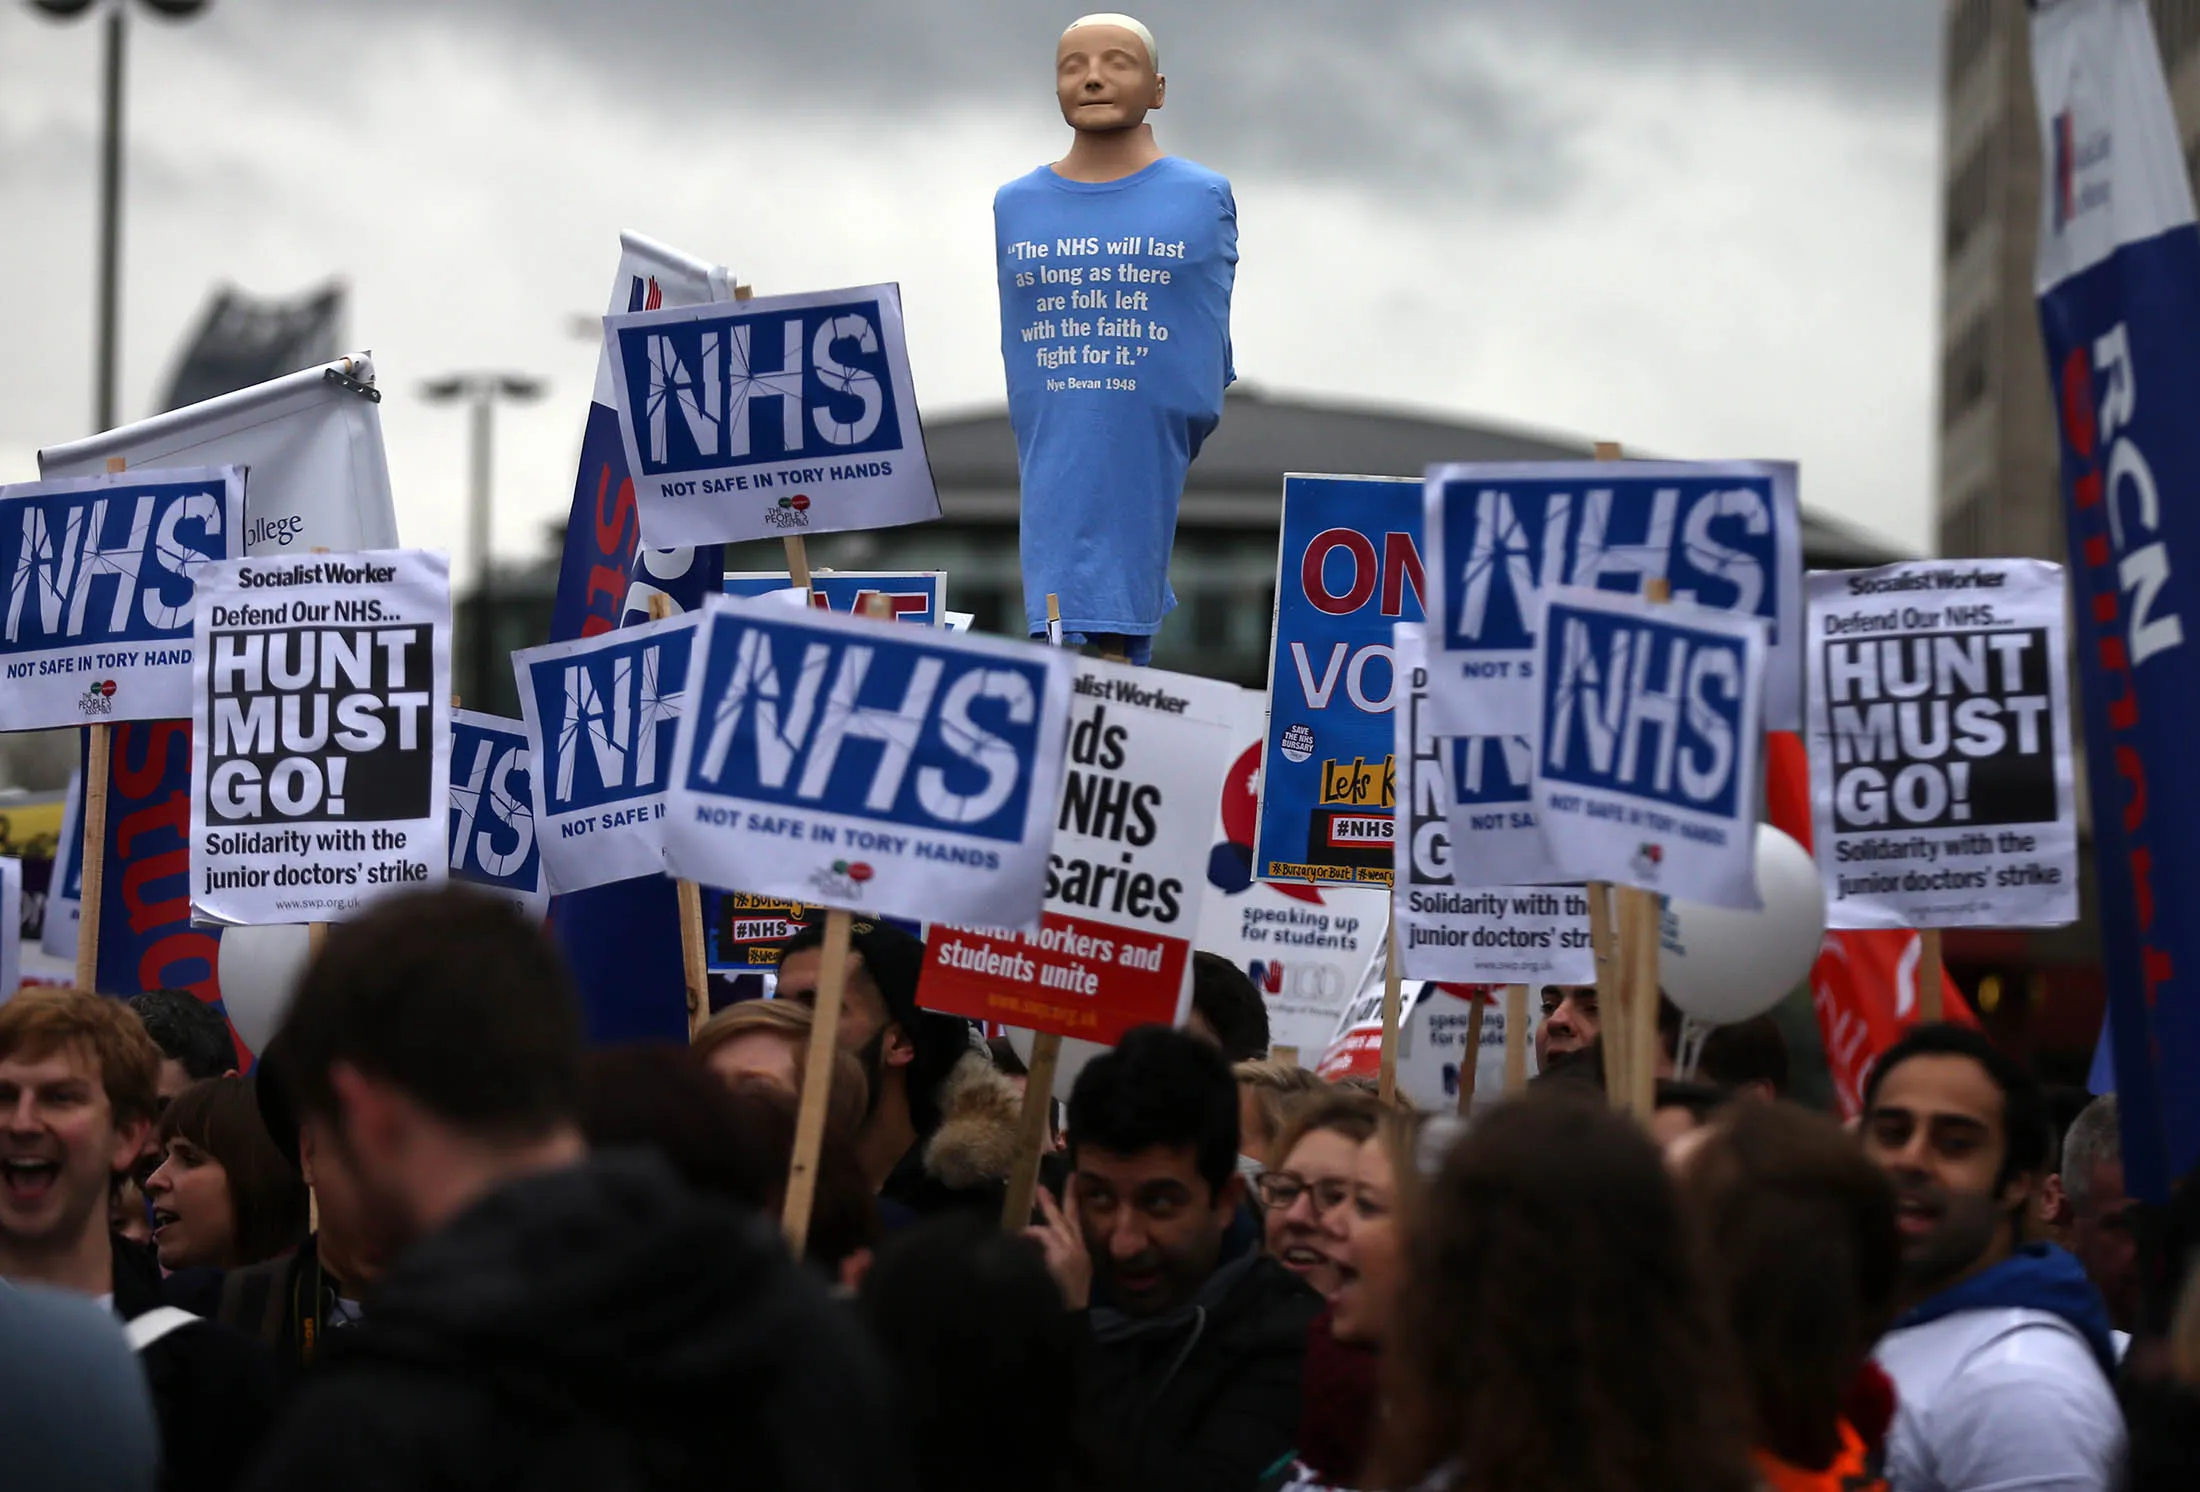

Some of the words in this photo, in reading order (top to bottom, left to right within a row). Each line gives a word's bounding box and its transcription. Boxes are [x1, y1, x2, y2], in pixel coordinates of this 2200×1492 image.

[1056, 237, 1099, 256] NHS
[1107, 237, 1141, 255] will
[1148, 237, 1185, 258] last
[1016, 271, 1035, 287] as
[1041, 265, 1083, 285] long
[1089, 267, 1111, 282] as
[1118, 263, 1171, 285] there
[1037, 296, 1065, 312] are
[1071, 289, 1108, 309] folk
[1115, 290, 1148, 311] left
[1021, 319, 1055, 342] with
[1061, 318, 1091, 337] the
[1097, 317, 1141, 338] faith
[1148, 321, 1168, 341] to
[1036, 346, 1077, 369] fight
[1082, 344, 1110, 364] for
[646, 313, 883, 464] NHS
[1047, 378, 1065, 392] Nye
[1068, 377, 1101, 389] Bevan
[1105, 378, 1136, 391] 1948
[660, 481, 697, 498] NOT
[702, 476, 749, 494] SAFE
[753, 472, 774, 488] IN
[778, 467, 825, 487] TORY
[831, 461, 893, 481] HANDS
[2093, 321, 2184, 667] RCN
[5, 492, 221, 643] NHS
[238, 563, 322, 588] Socialist
[324, 563, 396, 584] Worker
[1458, 488, 1770, 641] NHS
[1848, 571, 1933, 595] Socialist
[1936, 568, 2006, 589] Worker
[211, 602, 287, 627] Defend
[292, 600, 330, 622] Our
[335, 600, 401, 622] NHS...
[1824, 609, 1898, 635] Defend
[1902, 607, 1940, 629] Our
[7, 662, 35, 679] NOT
[39, 657, 74, 675] SAFE
[78, 656, 92, 671] IN
[97, 652, 138, 669] TORY
[144, 649, 194, 666] HAND
[214, 629, 416, 693] HUNT
[1462, 661, 1511, 679] NOT
[1827, 633, 2032, 701] HUNT
[1116, 680, 1190, 715] Worker
[1550, 616, 1739, 802] NHS
[213, 692, 429, 757] MUST
[699, 628, 1036, 824] NHS
[1070, 704, 1128, 770] ds
[1285, 731, 1298, 742] THE
[1291, 725, 1309, 736] SAVE
[1831, 695, 2048, 764] MUST
[1281, 739, 1314, 752] BURSARY
[208, 756, 347, 820] GO!
[1836, 761, 1971, 826] GO!
[562, 817, 596, 838] NOT
[602, 806, 649, 829] SAFE
[1058, 770, 1162, 847] NHS
[1470, 813, 1507, 831] NOT
[1509, 811, 1537, 830] SA
[205, 831, 311, 857] Solidarity
[316, 828, 366, 851] with
[371, 828, 407, 850] the
[695, 806, 738, 830] NOT
[747, 815, 804, 840] SAFE
[811, 825, 838, 846] IN
[845, 829, 911, 857] TORY
[915, 841, 1001, 872] HANDS
[1337, 820, 1394, 838] #NHS
[1835, 836, 1938, 862] Solidarity
[1944, 832, 1993, 856] with
[1997, 831, 2036, 852] the
[204, 865, 270, 894] junior
[273, 862, 363, 887] doctors'
[367, 859, 428, 884] strike
[1836, 873, 1899, 900] junior
[1902, 866, 1992, 892] doctors'
[1996, 862, 2061, 887] strike
[275, 899, 360, 912] www.swp.org.uk
[1242, 907, 1330, 931] speaking
[1335, 914, 1359, 933] up
[1409, 891, 1506, 919] Solidarity
[1513, 892, 1560, 916] with
[1565, 892, 1590, 916] th
[736, 920, 788, 939] #NHS
[1241, 924, 1272, 941] for
[1274, 928, 1358, 951] students
[1408, 924, 1469, 950] junior
[1472, 925, 1556, 949] doctors'
[938, 938, 1035, 984] students
[1040, 960, 1099, 995] unite
[1119, 943, 1164, 973] and
